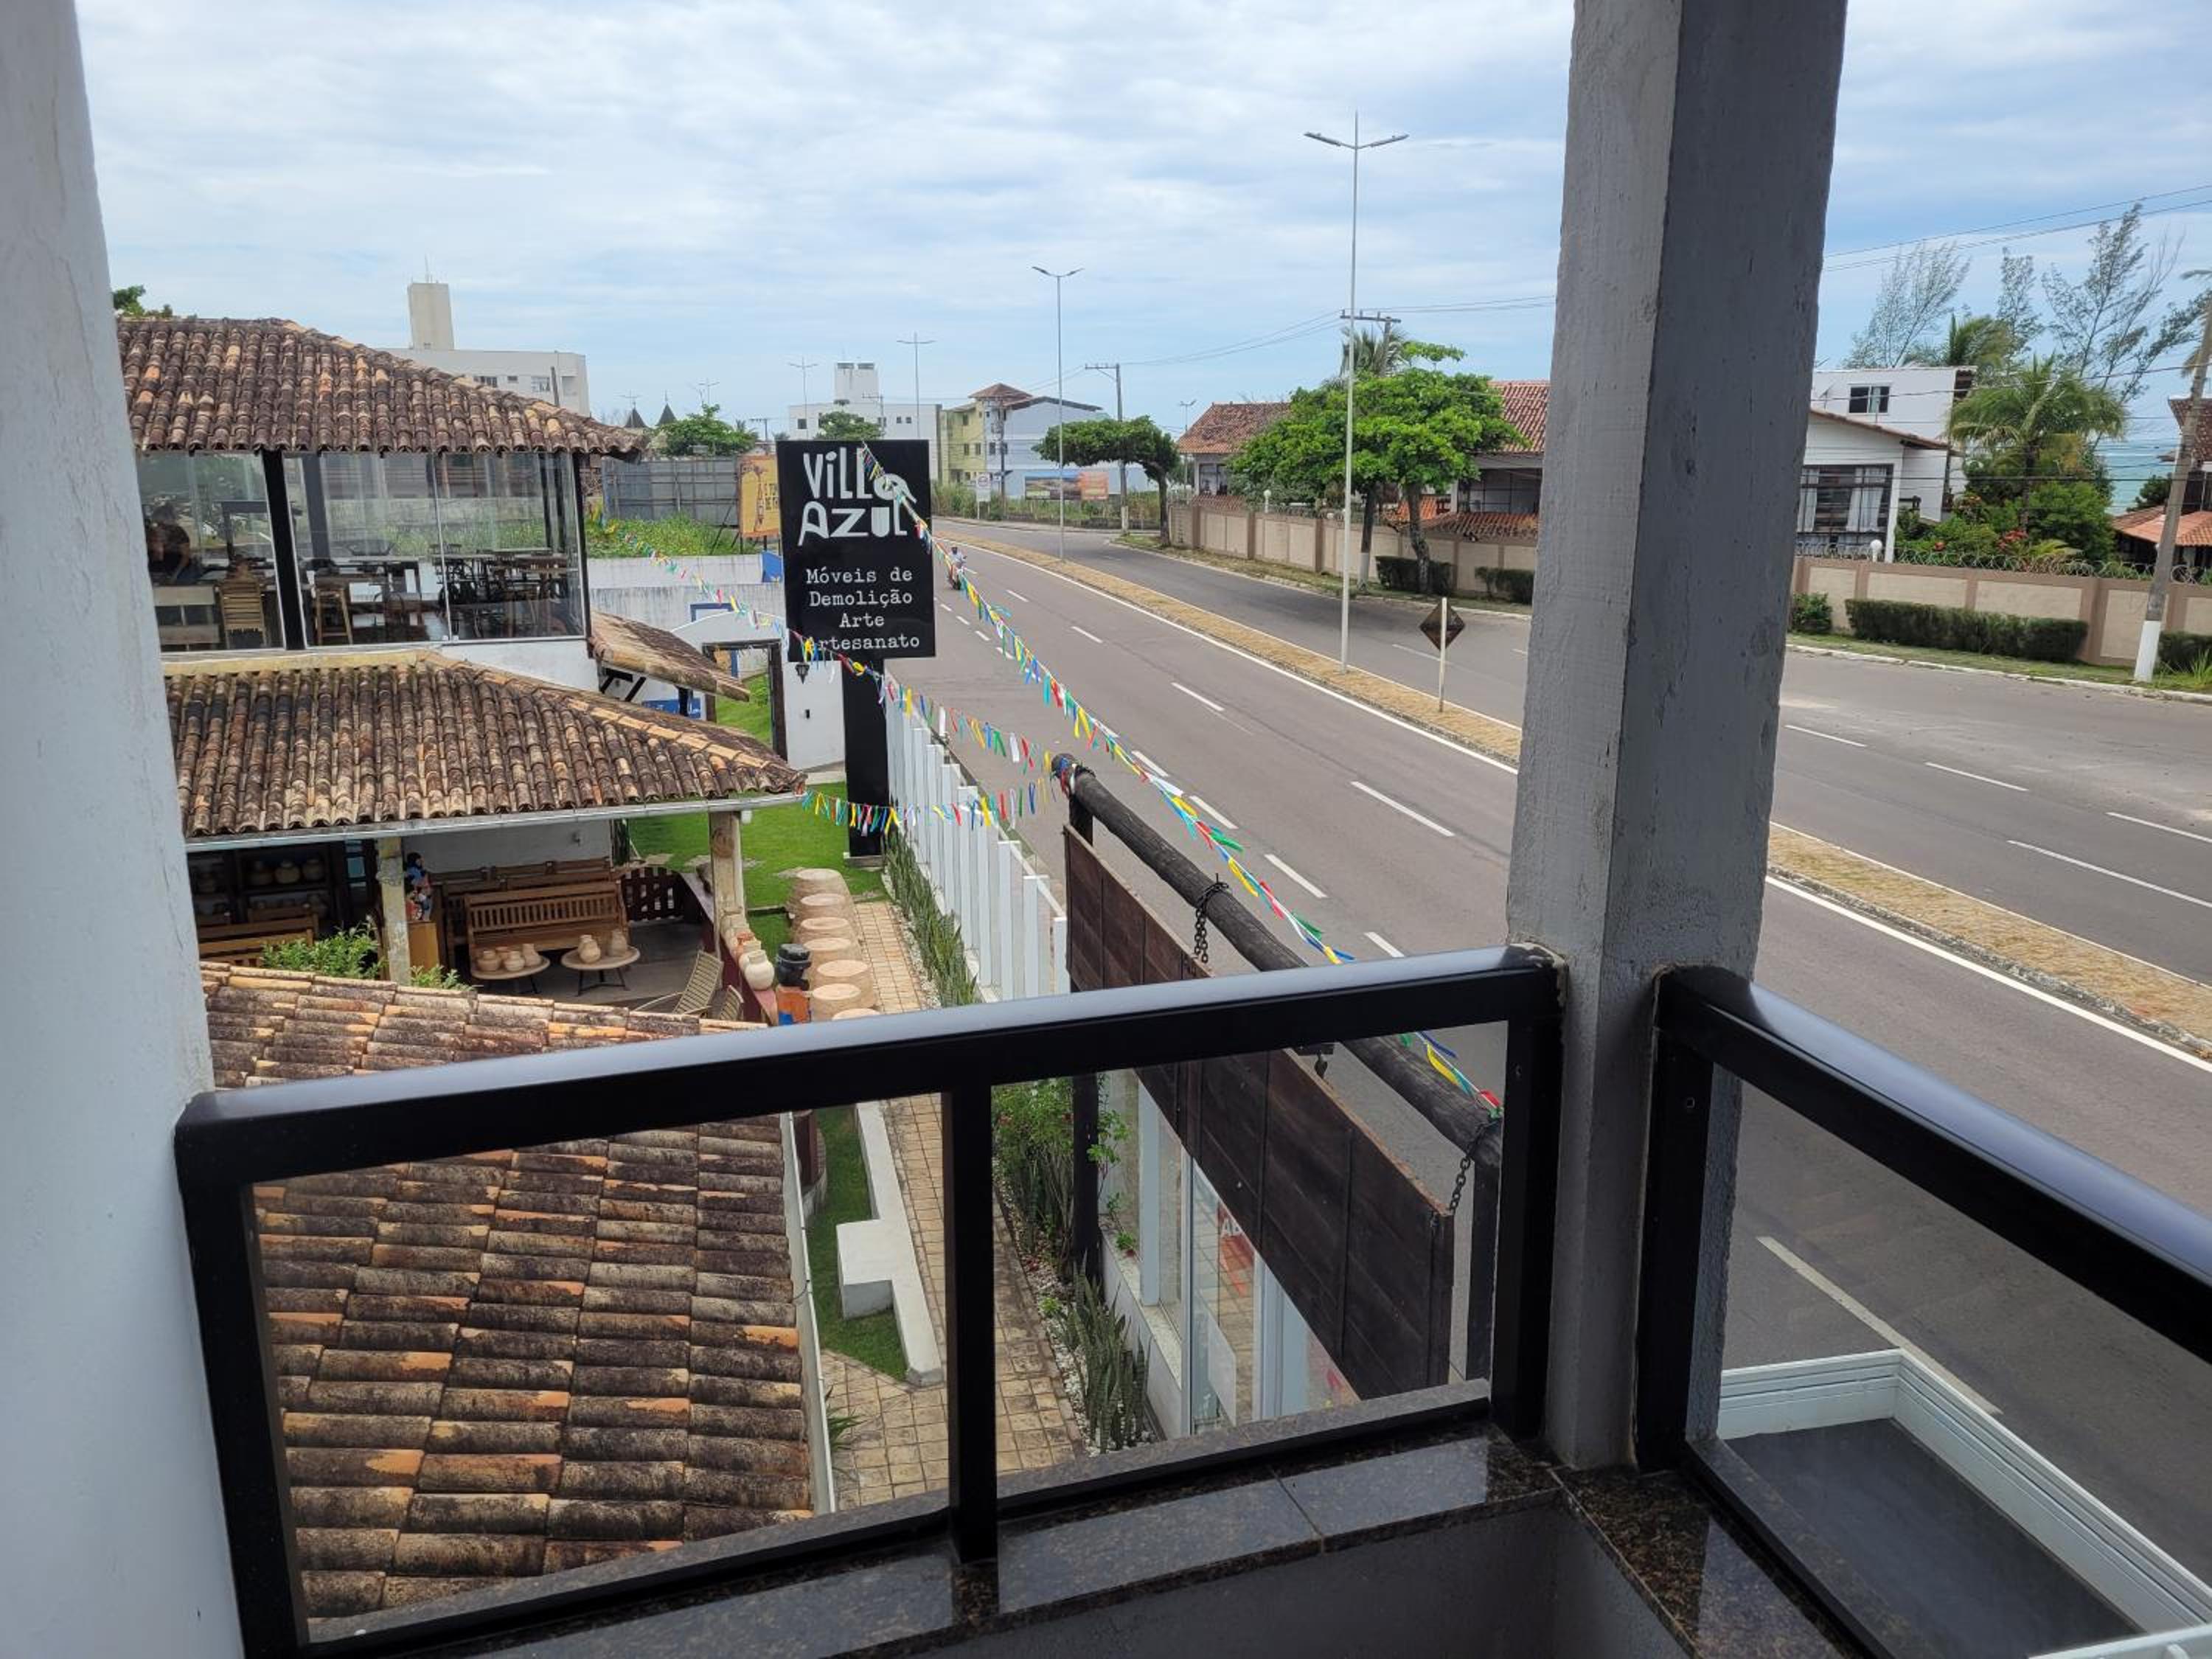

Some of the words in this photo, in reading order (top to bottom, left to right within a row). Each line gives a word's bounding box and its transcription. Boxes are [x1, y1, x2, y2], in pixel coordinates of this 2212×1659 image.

[806, 566, 877, 584] Móveis
[890, 566, 913, 582] de
[810, 589, 913, 608] Demolição
[839, 613, 885, 627] Arte
[808, 633, 920, 651] rtesanato
